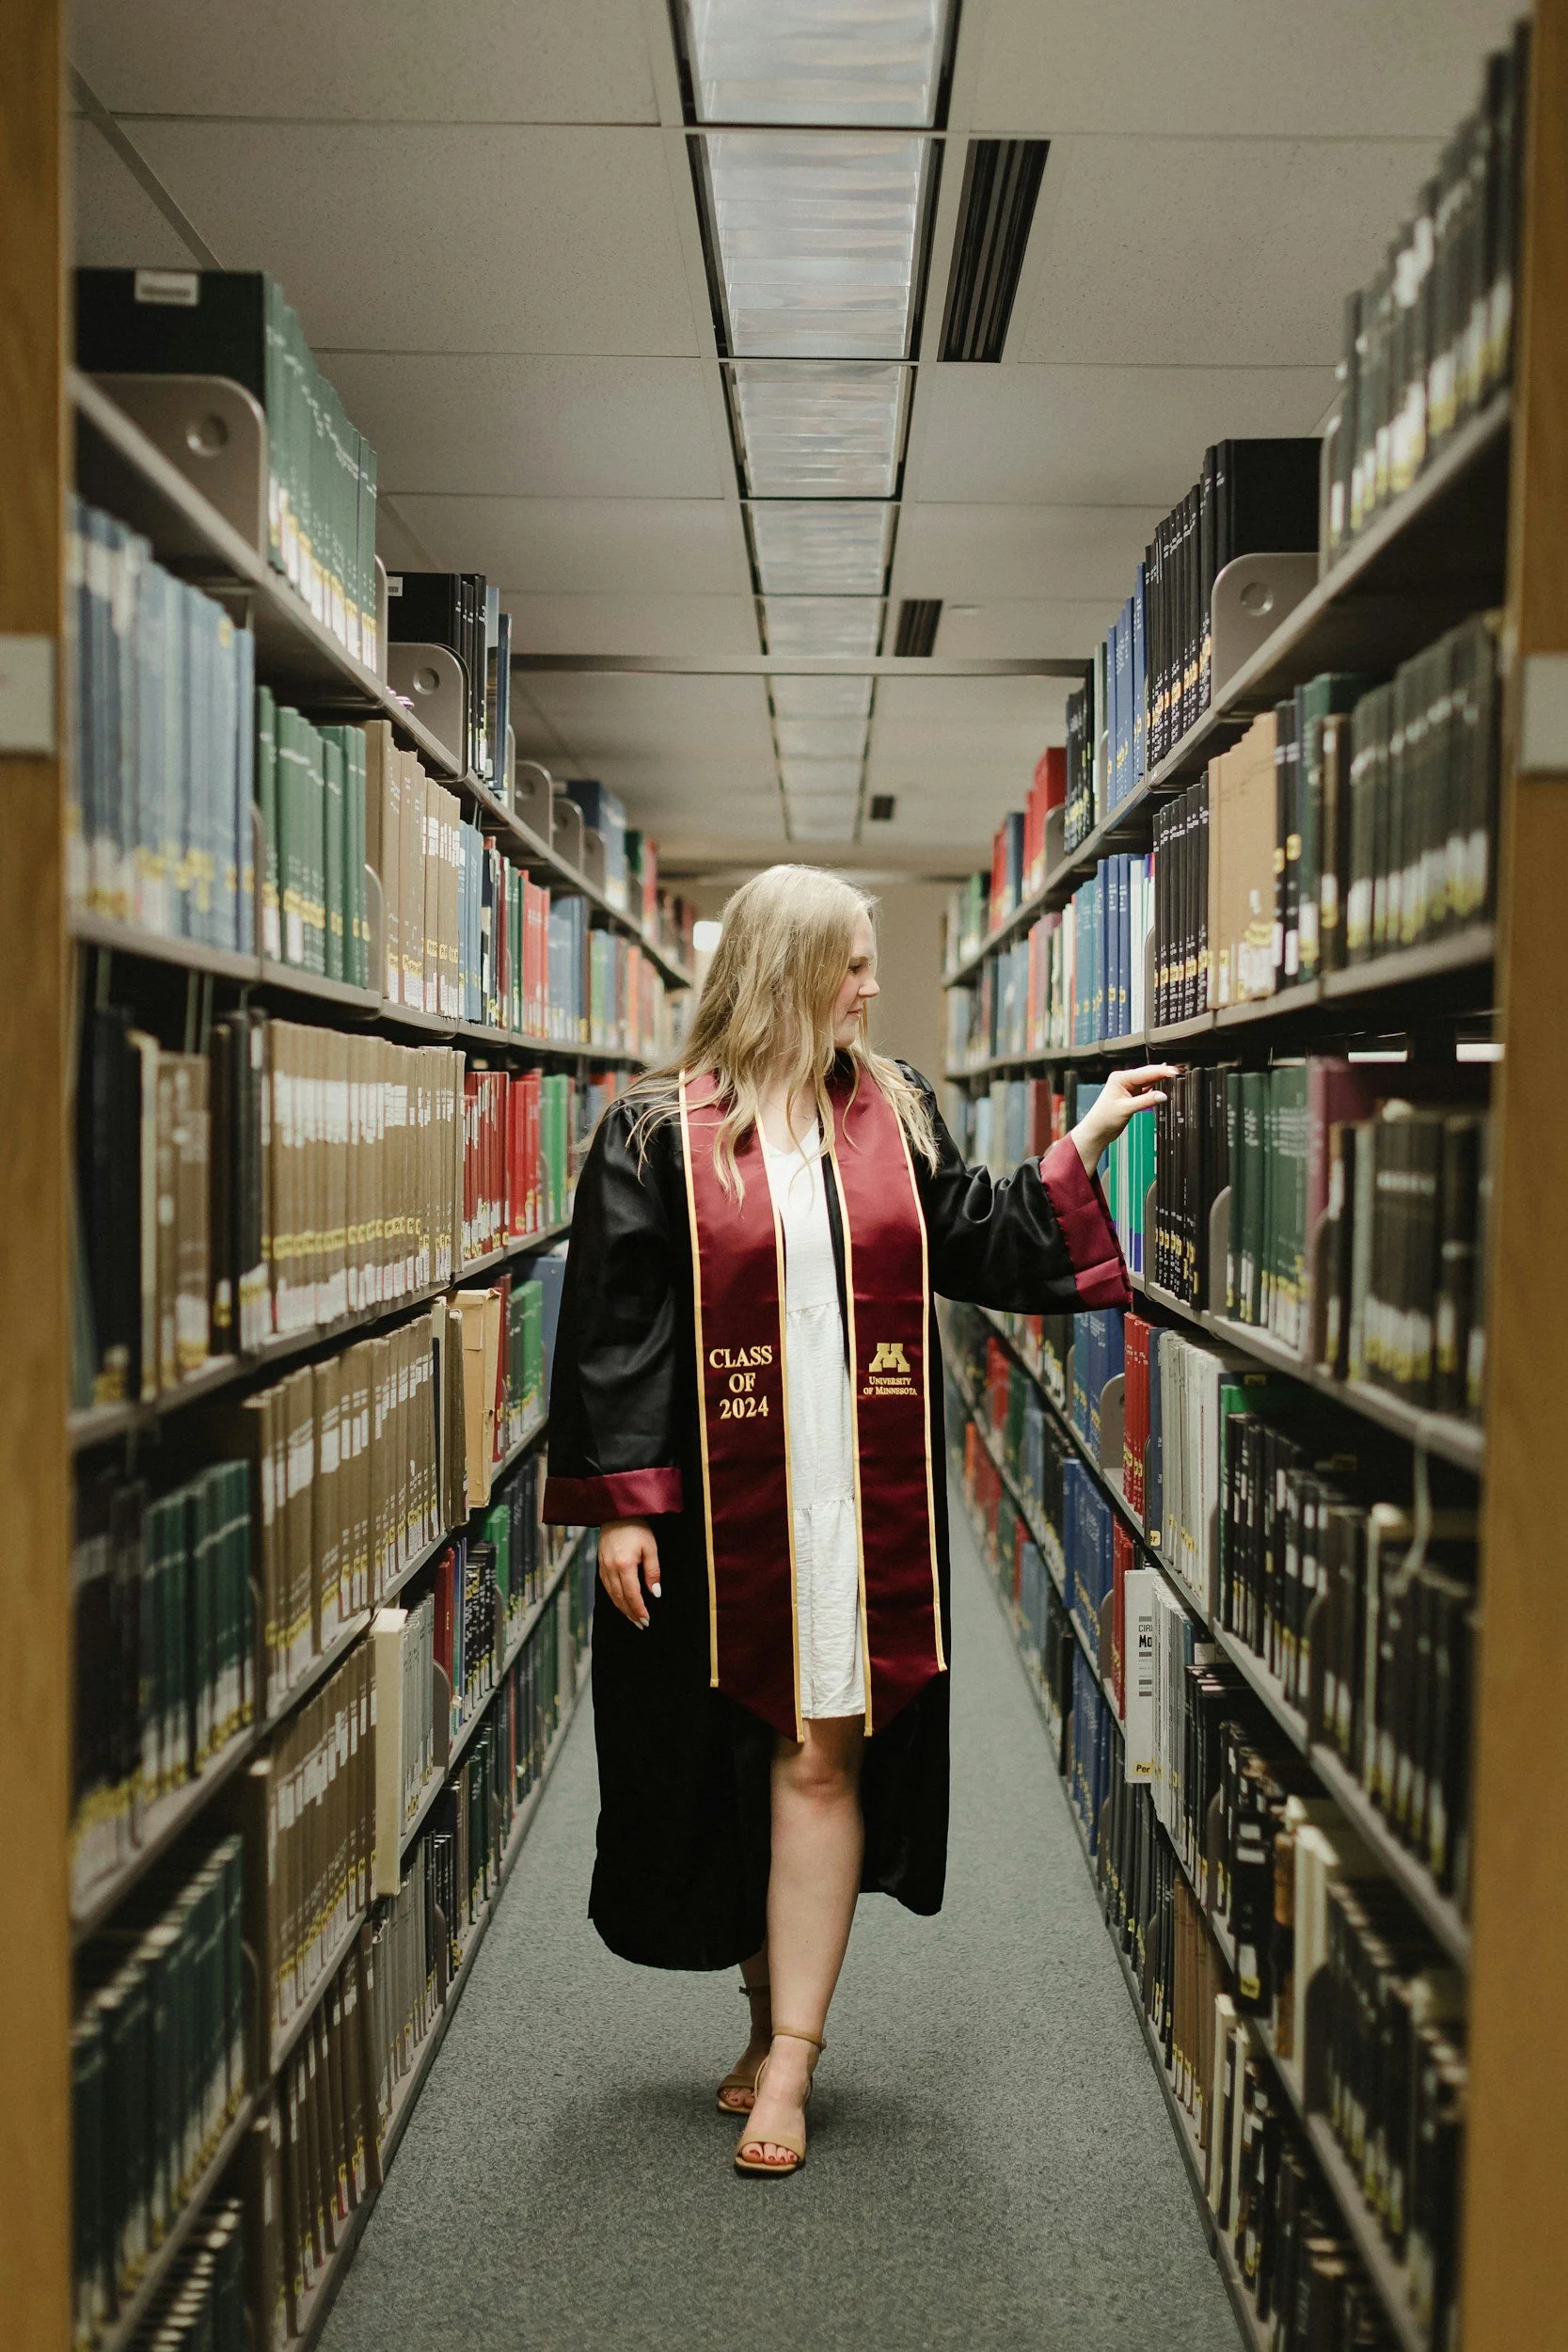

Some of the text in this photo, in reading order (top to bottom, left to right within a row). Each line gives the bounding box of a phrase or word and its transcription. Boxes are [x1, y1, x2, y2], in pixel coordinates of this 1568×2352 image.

[709, 1345, 773, 1369] CLASS
[868, 1343, 911, 1373] M
[728, 1372, 756, 1393] OF
[868, 1375, 911, 1386] UNIVERSITY
[875, 1386, 918, 1395] MINNESOTA
[719, 1395, 769, 1420] 2024
[1138, 1624, 1153, 1632] CIR
[1135, 1763, 1150, 1773] Per
